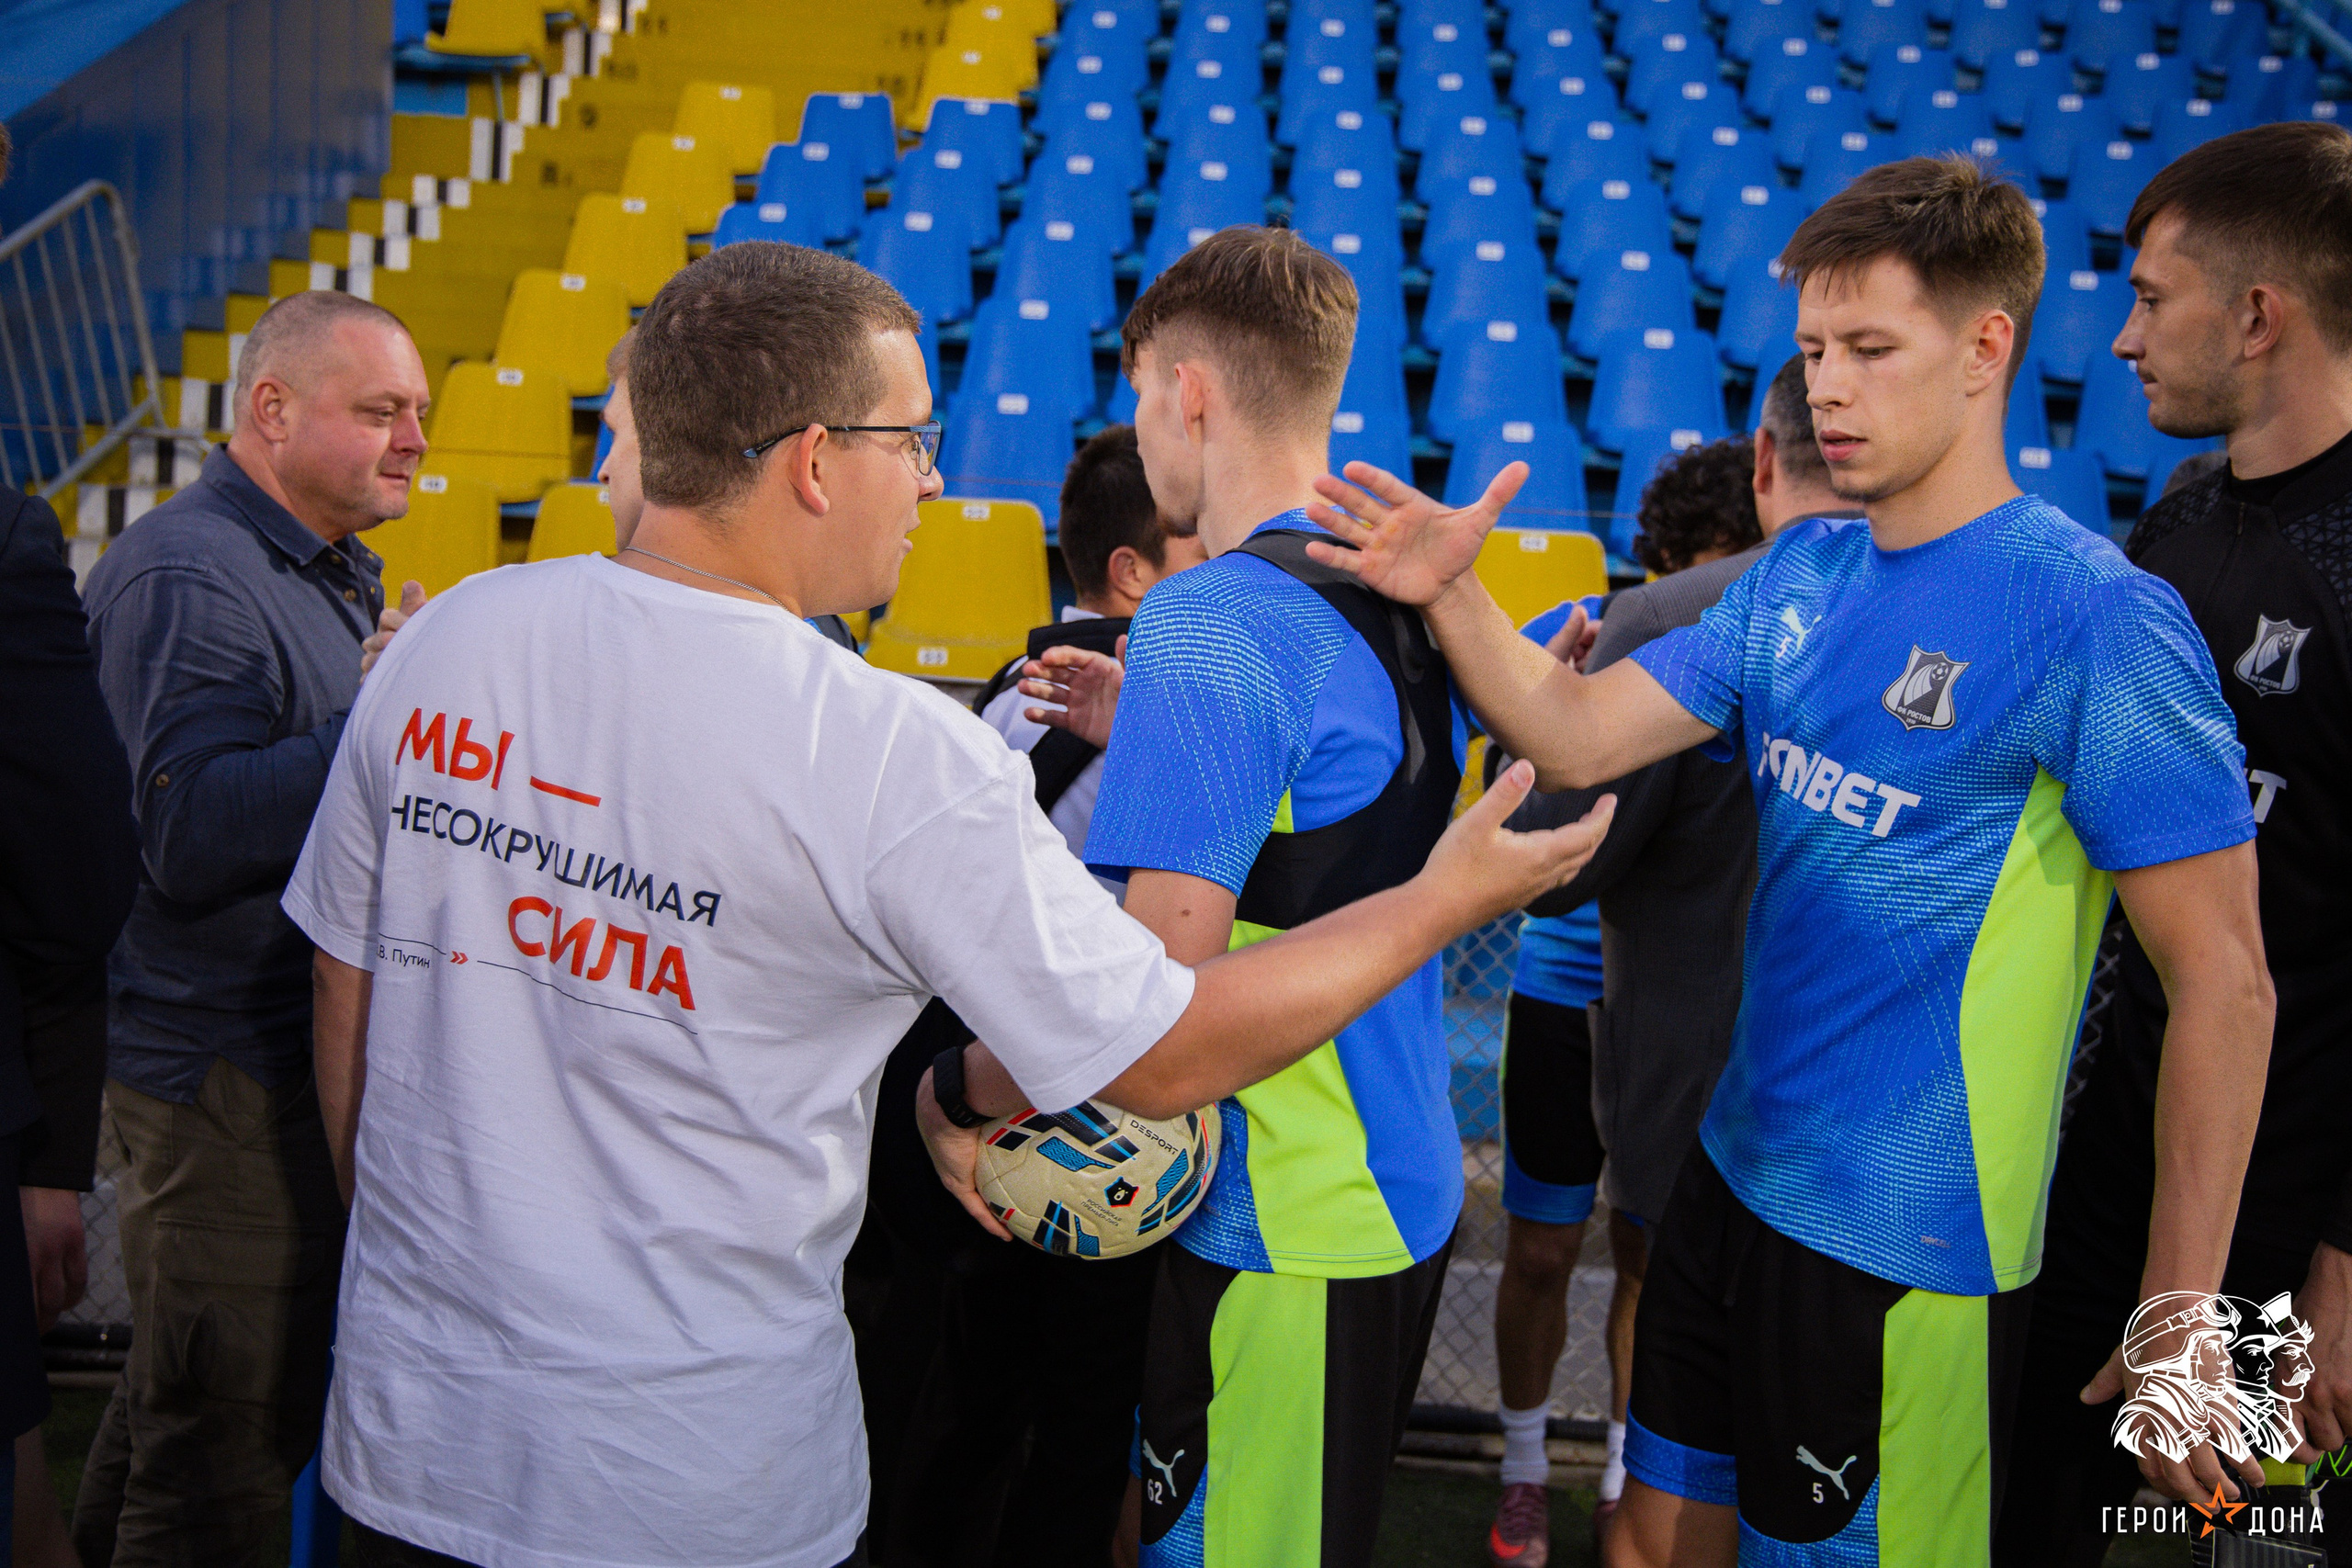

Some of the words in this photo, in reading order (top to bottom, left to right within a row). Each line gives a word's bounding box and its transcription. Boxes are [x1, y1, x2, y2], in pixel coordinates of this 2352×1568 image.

[1906, 709, 1932, 724] РОСТОВ
[396, 707, 515, 791] МЫ
[391, 794, 722, 928] НЕСОКРУШИМАЯ
[392, 948, 430, 968] Путин
[507, 896, 696, 1011] СИЛА
[1130, 1120, 1179, 1156] DESPORT
[1147, 1478, 1163, 1506] 62
[1813, 1482, 1824, 1504] 5
